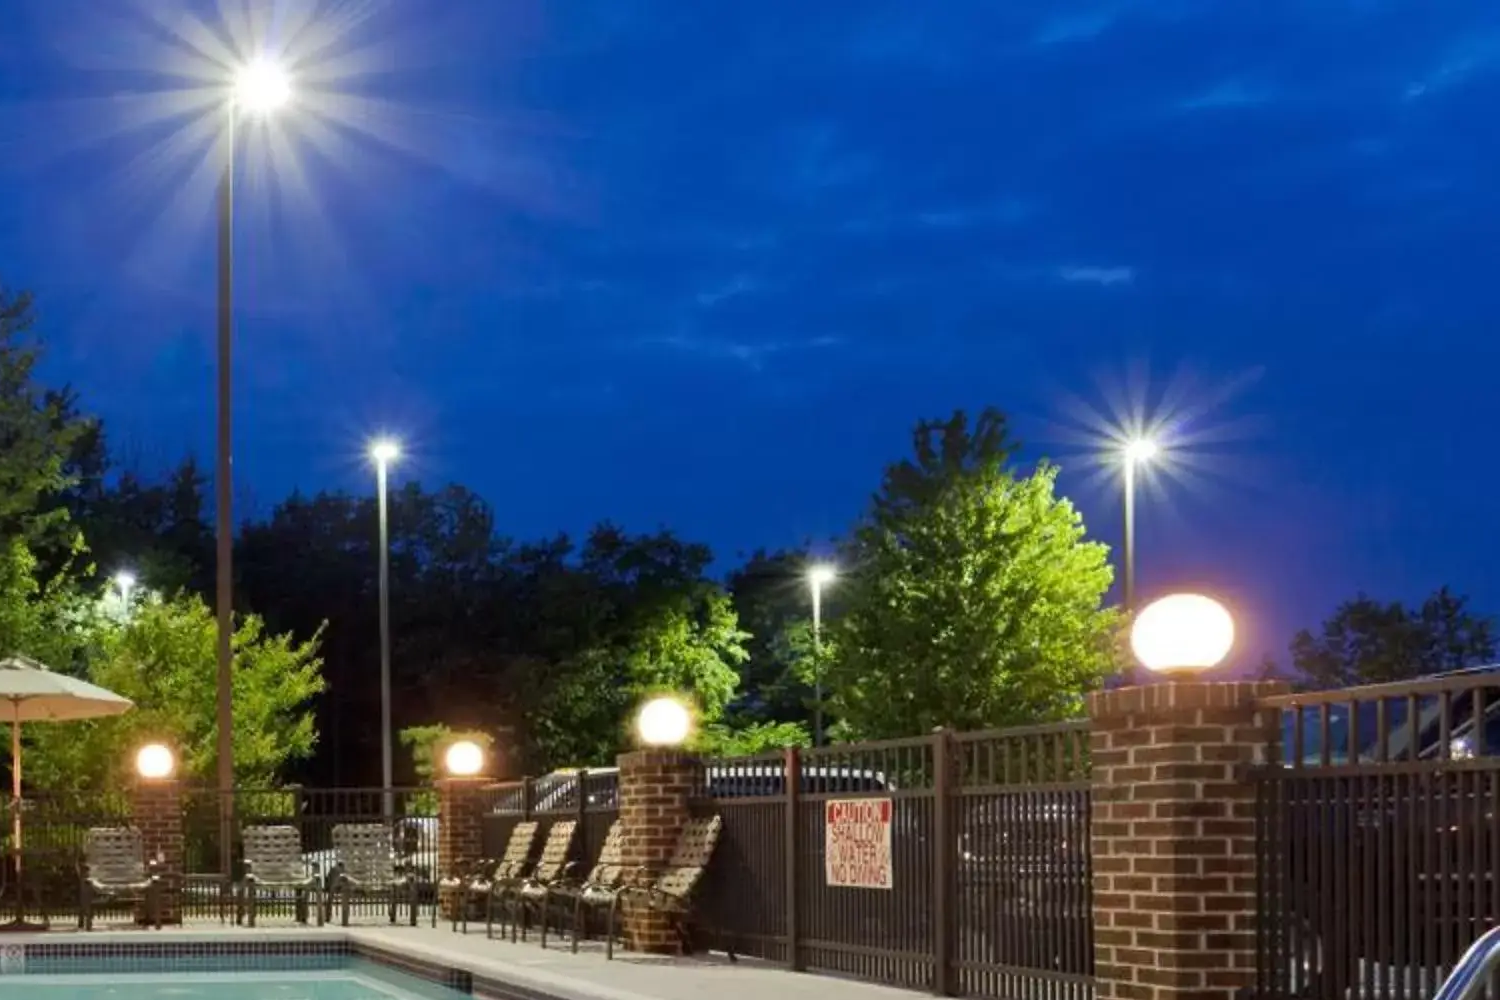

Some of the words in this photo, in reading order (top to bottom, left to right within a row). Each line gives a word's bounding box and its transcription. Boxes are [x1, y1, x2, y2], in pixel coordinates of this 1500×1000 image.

[834, 801, 881, 822] CAUTION
[832, 822, 885, 844] SHALLOW
[839, 842, 877, 864] WATER
[832, 863, 847, 882] NO
[849, 864, 887, 885] DIVING
